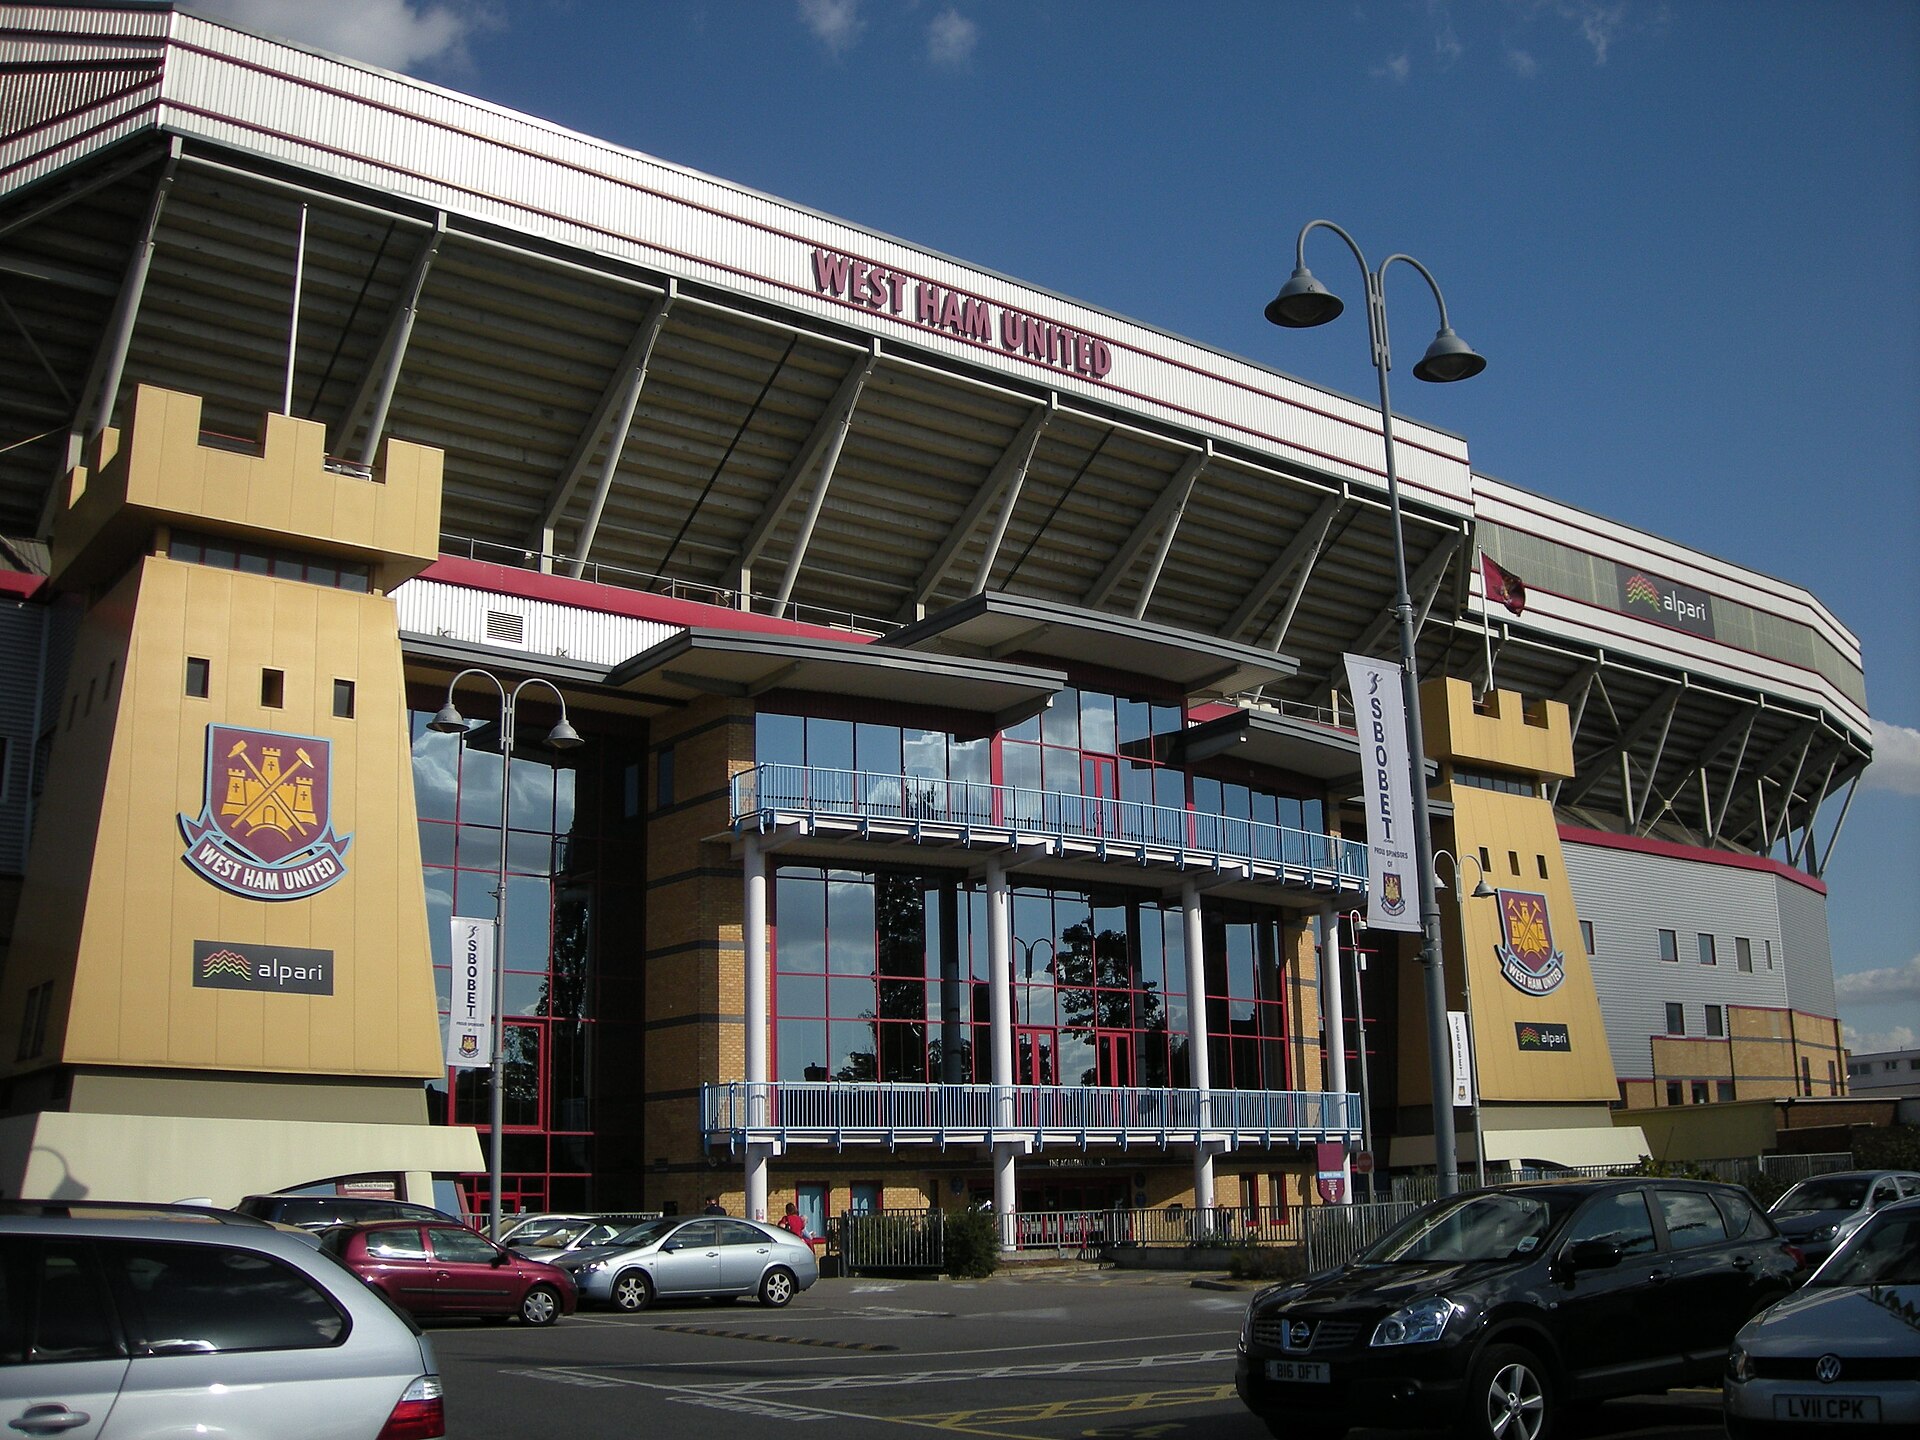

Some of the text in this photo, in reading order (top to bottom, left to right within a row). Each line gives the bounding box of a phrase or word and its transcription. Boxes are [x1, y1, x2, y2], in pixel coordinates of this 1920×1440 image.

[812, 249, 1112, 378] WEST HAM UNITED
[1663, 590, 1706, 621] alpari
[1371, 697, 1393, 839] SBOBET
[198, 843, 337, 890] WEST HAM UNITED
[257, 958, 323, 985] alpari
[466, 939, 478, 1018] SBOBET
[1509, 962, 1562, 990] WEST HAM UNITED
[1541, 1030, 1567, 1047] alpari
[1298, 1363, 1321, 1380] DFT
[1826, 1399, 1864, 1419] CPK
